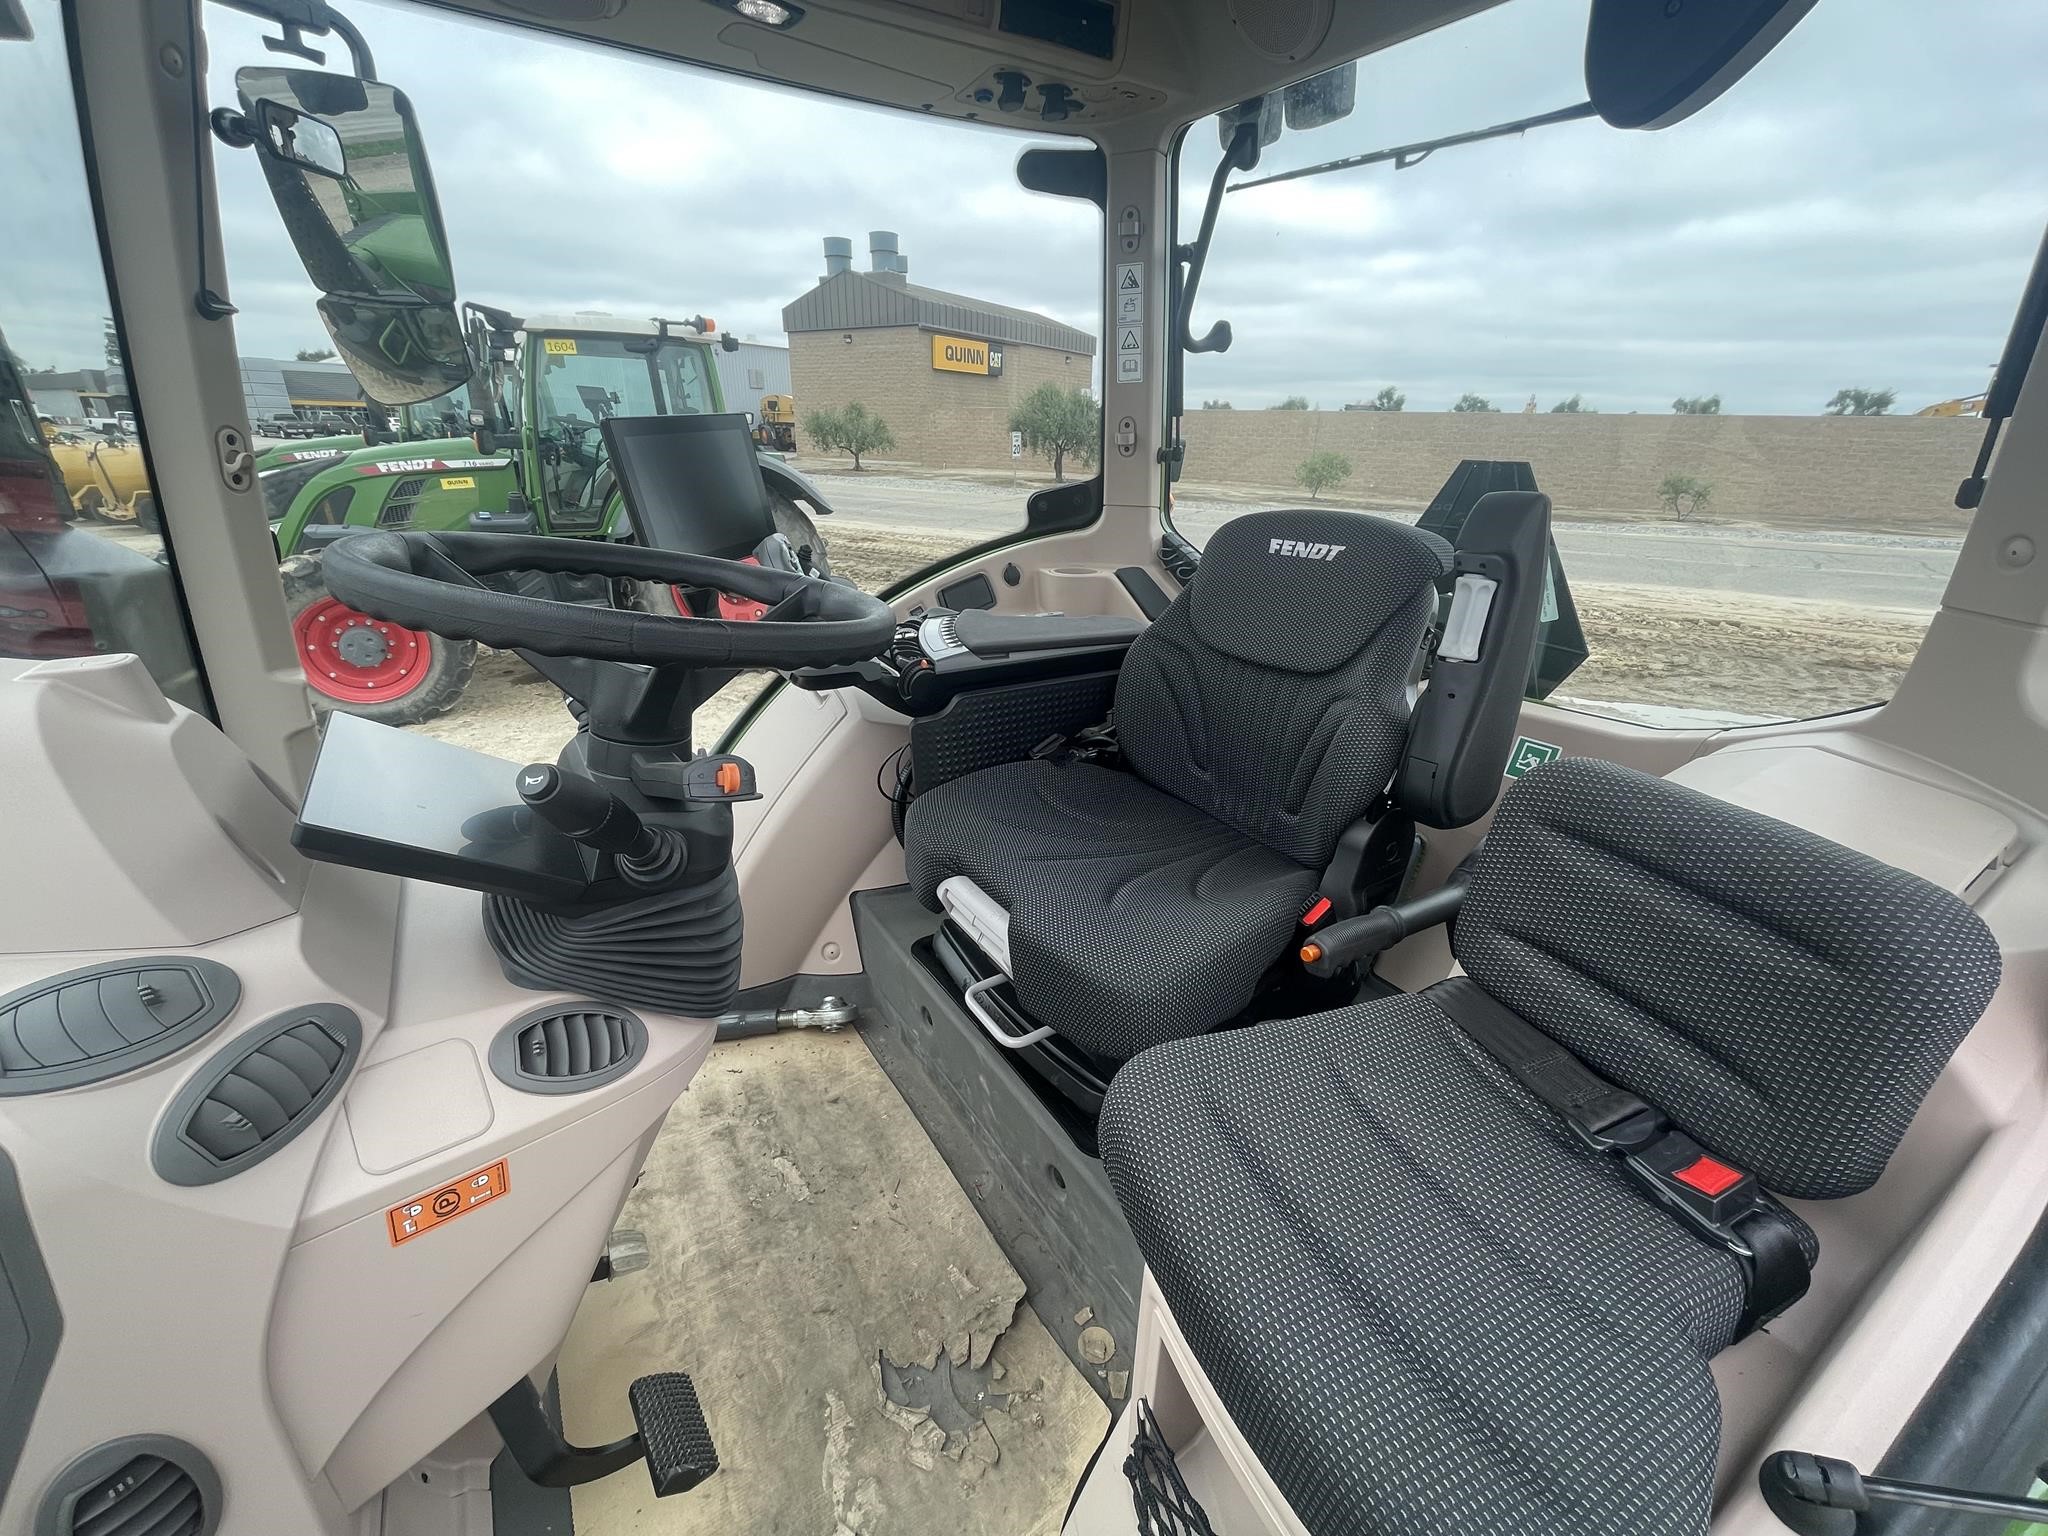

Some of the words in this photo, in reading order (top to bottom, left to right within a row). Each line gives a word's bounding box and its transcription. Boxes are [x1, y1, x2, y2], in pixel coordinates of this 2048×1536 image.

[547, 342, 575, 352] 1604
[945, 345, 984, 365] QUINN
[990, 352, 1001, 367] CAT
[293, 449, 337, 460] FENDT
[1013, 444, 1021, 455] 20
[376, 459, 435, 472] FENDT
[1268, 538, 1346, 561] FENDT
